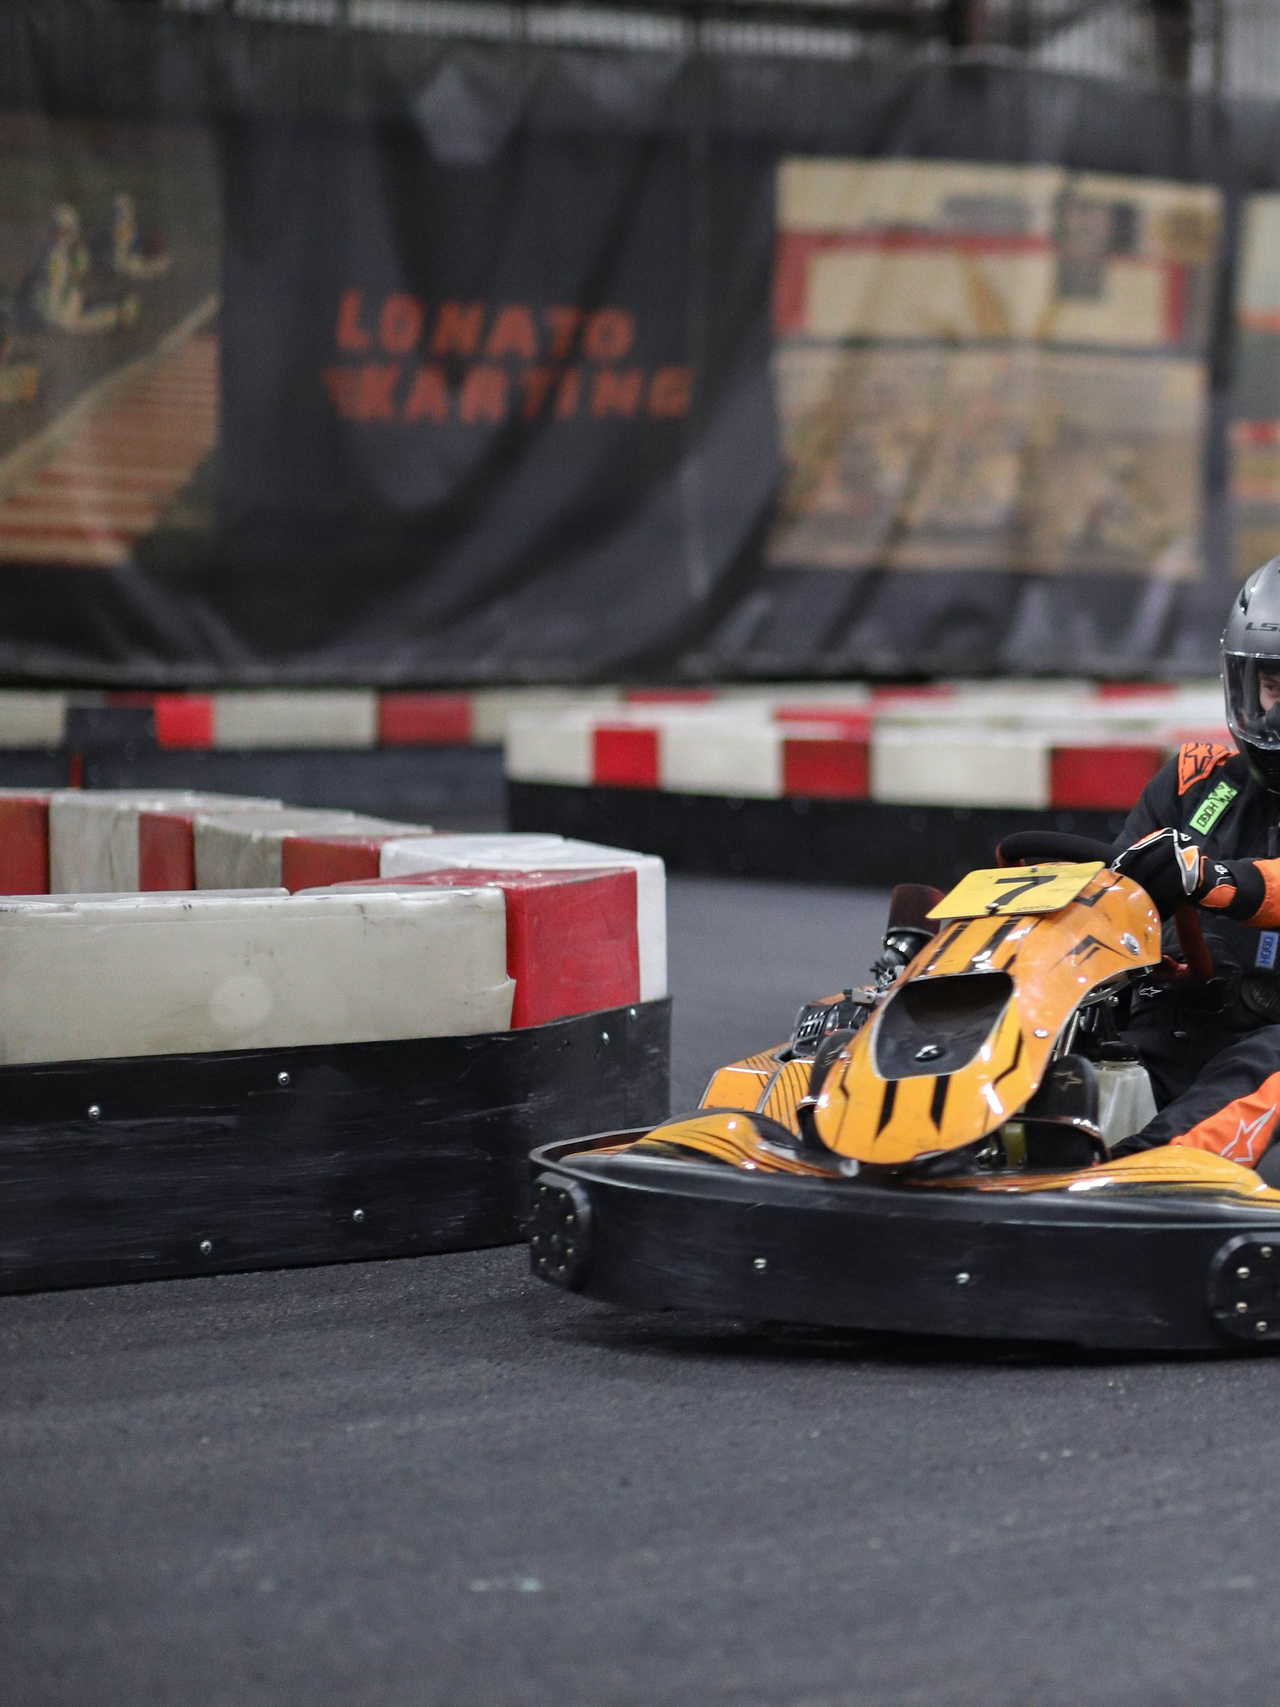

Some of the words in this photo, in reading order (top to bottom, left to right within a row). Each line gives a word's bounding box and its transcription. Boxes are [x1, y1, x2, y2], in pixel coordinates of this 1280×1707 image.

[334, 287, 635, 358] LONATO
[322, 364, 693, 424] KARTING
[992, 875, 1058, 906] 7
